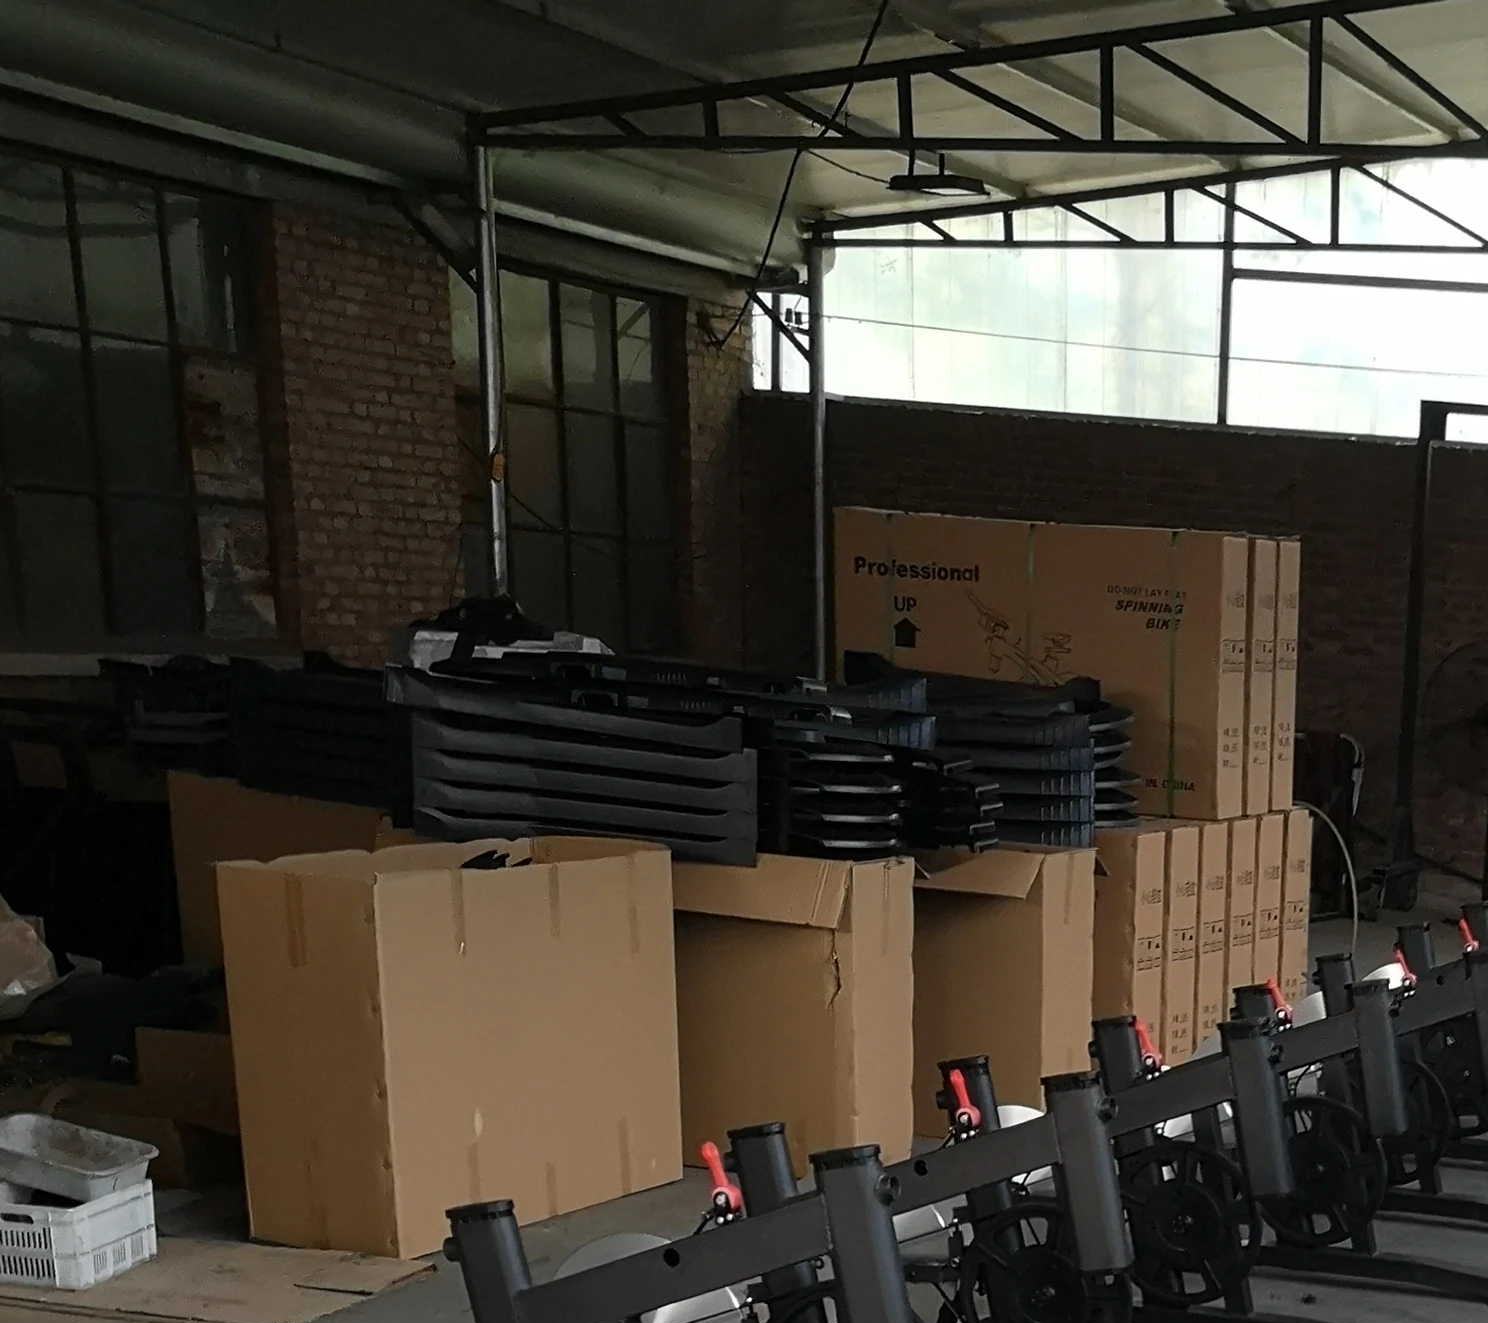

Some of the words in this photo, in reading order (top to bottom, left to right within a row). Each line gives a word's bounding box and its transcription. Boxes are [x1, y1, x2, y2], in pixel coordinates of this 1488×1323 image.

[853, 555, 980, 583] Professional
[893, 595, 917, 613] UP
[1114, 600, 1185, 615] SPINNING
